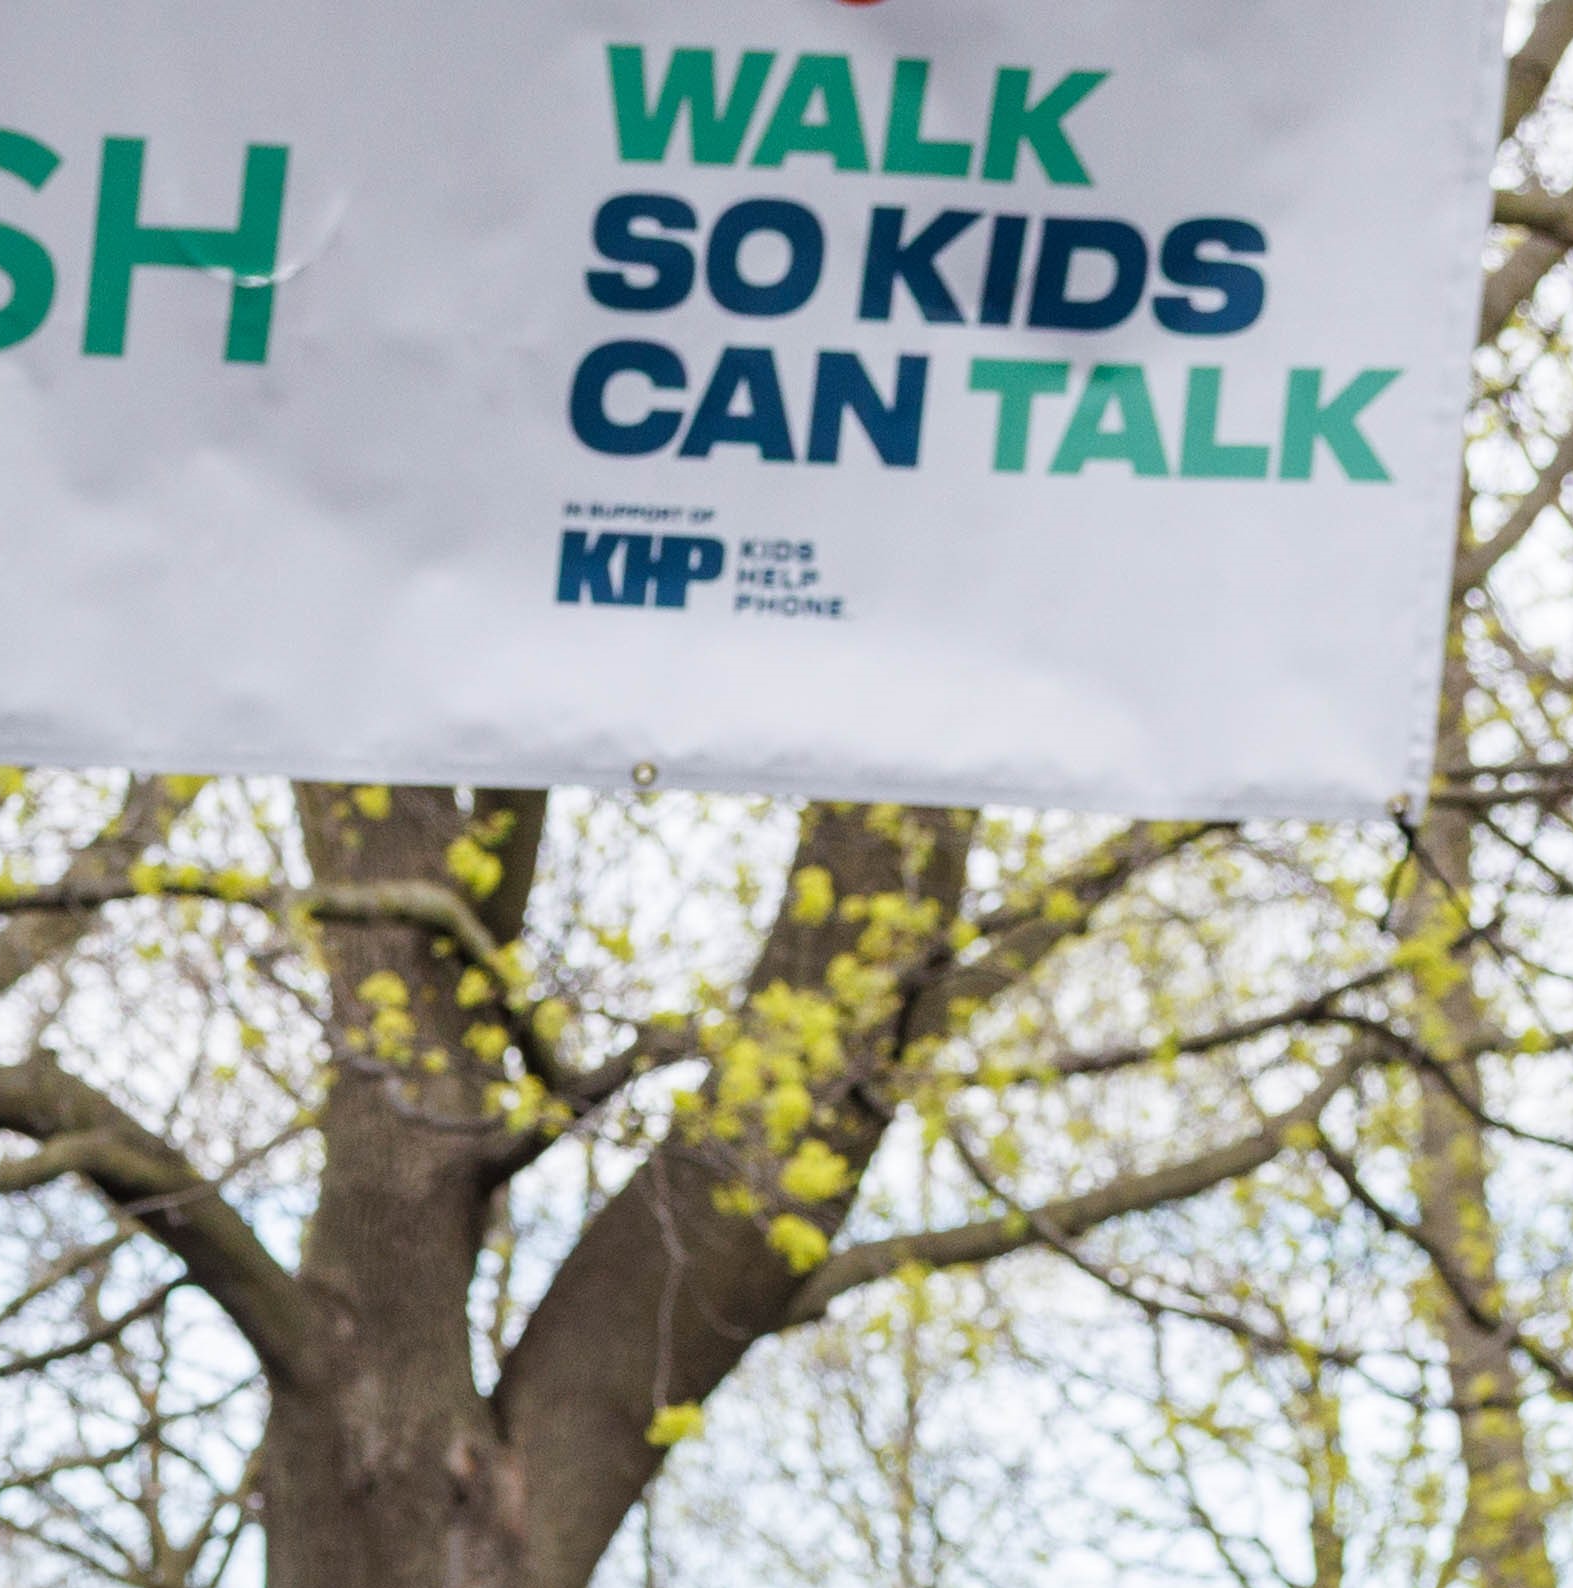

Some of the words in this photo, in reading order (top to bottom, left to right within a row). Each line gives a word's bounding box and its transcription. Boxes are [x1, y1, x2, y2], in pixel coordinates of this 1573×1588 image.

[605, 42, 1110, 188] WALK
[582, 190, 828, 320] SO
[856, 203, 1268, 338] KIDS
[566, 337, 931, 470] CAN
[966, 356, 1402, 484] TALK
[556, 530, 725, 610] KHP
[735, 567, 819, 589] HELP
[739, 538, 815, 562] KIDS
[735, 595, 845, 620] PHONE
